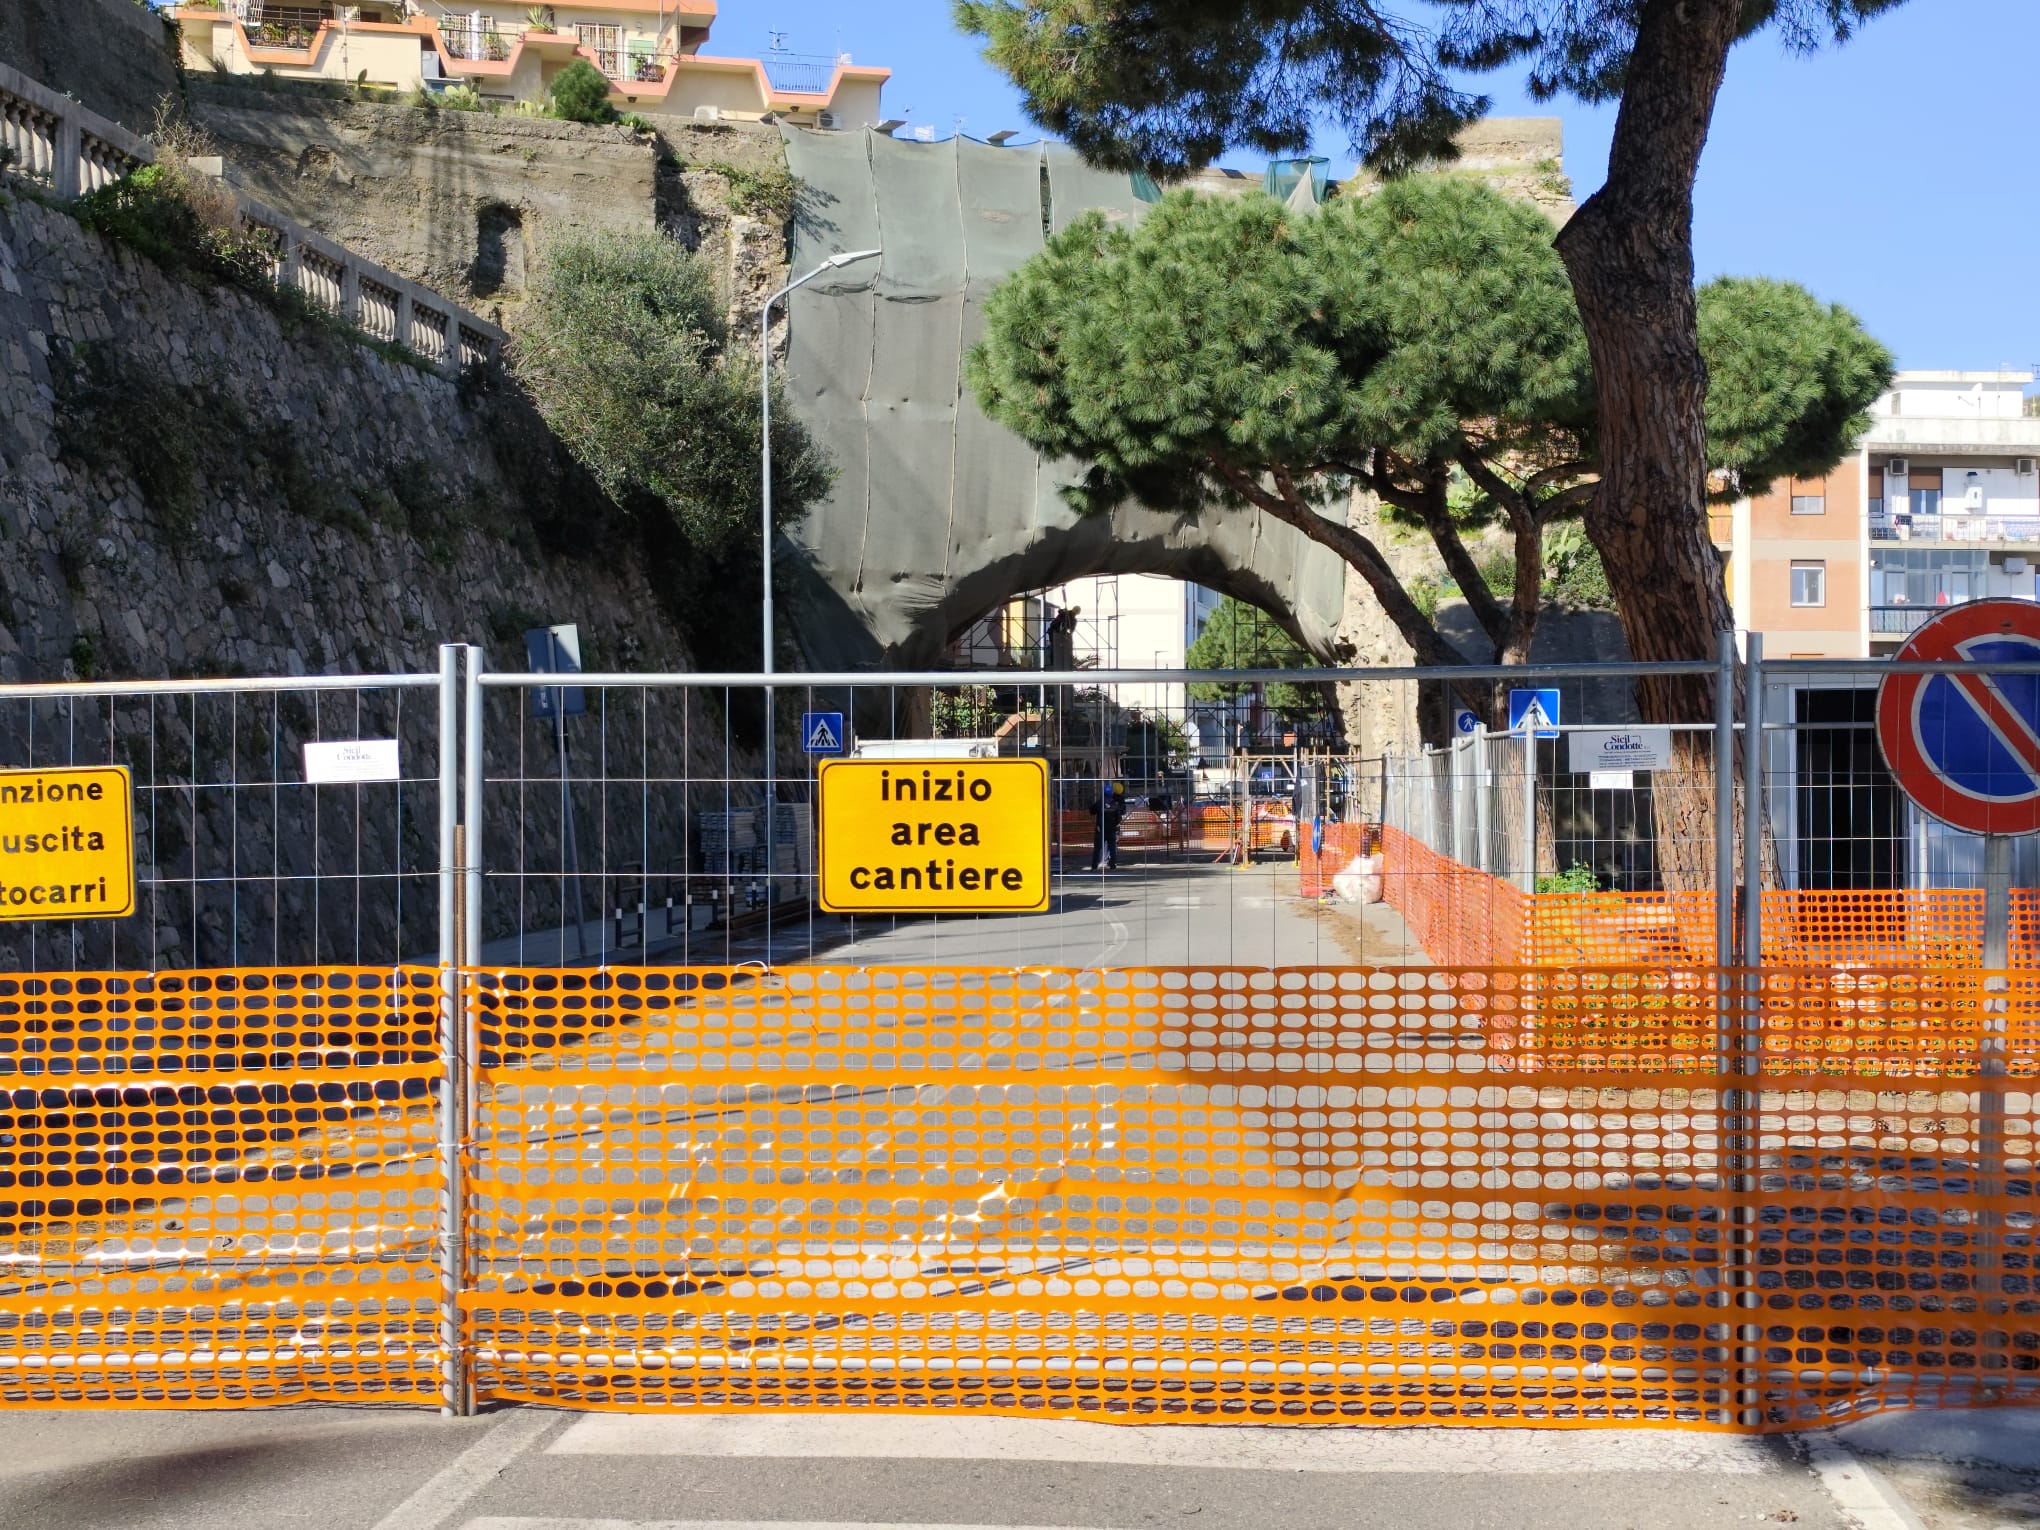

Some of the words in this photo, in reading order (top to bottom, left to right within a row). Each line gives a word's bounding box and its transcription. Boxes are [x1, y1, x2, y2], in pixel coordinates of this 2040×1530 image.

[1604, 741, 1643, 751] Condotte
[2, 778, 104, 804] nzione
[881, 770, 991, 802] inizio
[3, 826, 105, 853] uscita
[891, 822, 980, 846] area
[850, 859, 1022, 891] cantiere
